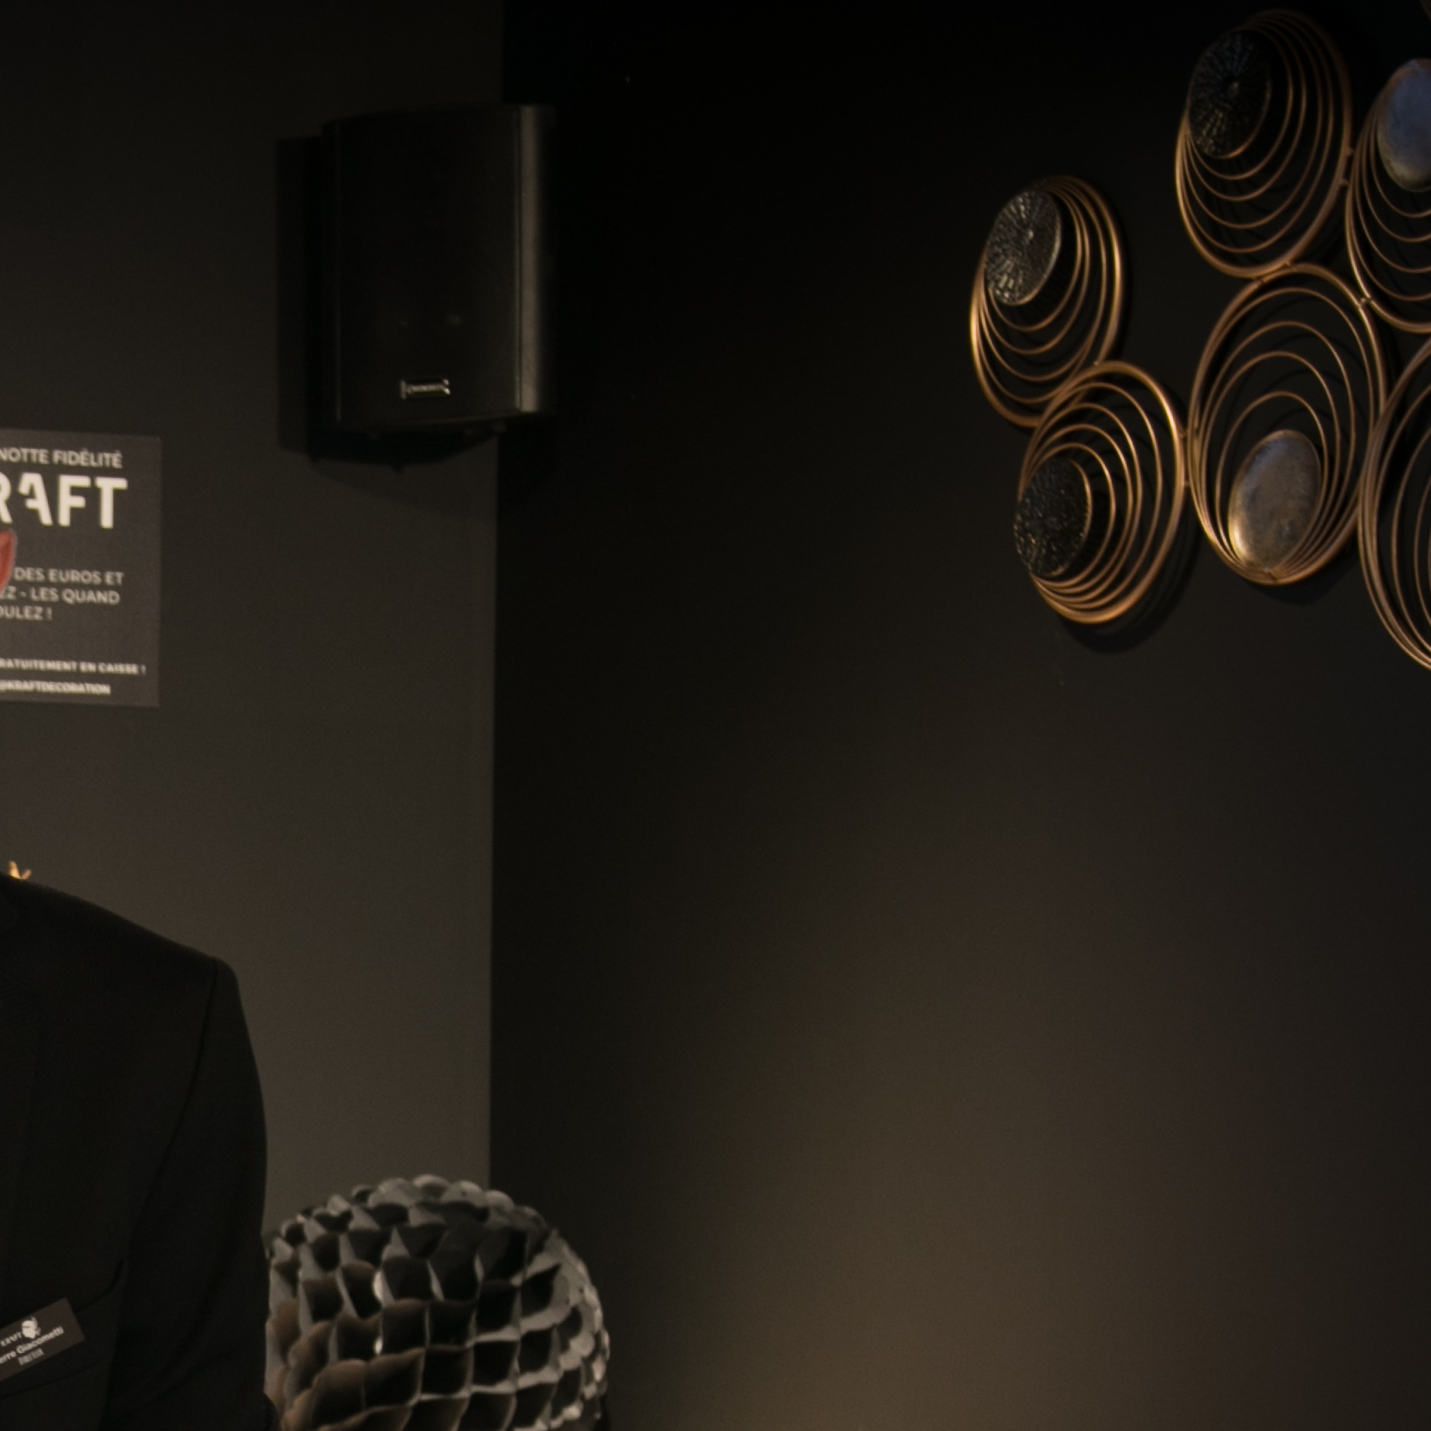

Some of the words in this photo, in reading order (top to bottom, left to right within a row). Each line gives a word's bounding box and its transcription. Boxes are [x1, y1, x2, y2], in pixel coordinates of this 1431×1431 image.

[52, 447, 123, 469] FIDÉLITÉ
[13, 566, 46, 583] DES
[48, 568, 103, 586] EUROS
[104, 570, 125, 587] ET
[30, 586, 60, 602] LES
[61, 588, 121, 606] QUAND
[79, 661, 96, 673] EN
[98, 662, 139, 675] CAISSE
[16, 1325, 65, 1354] Giacometti
